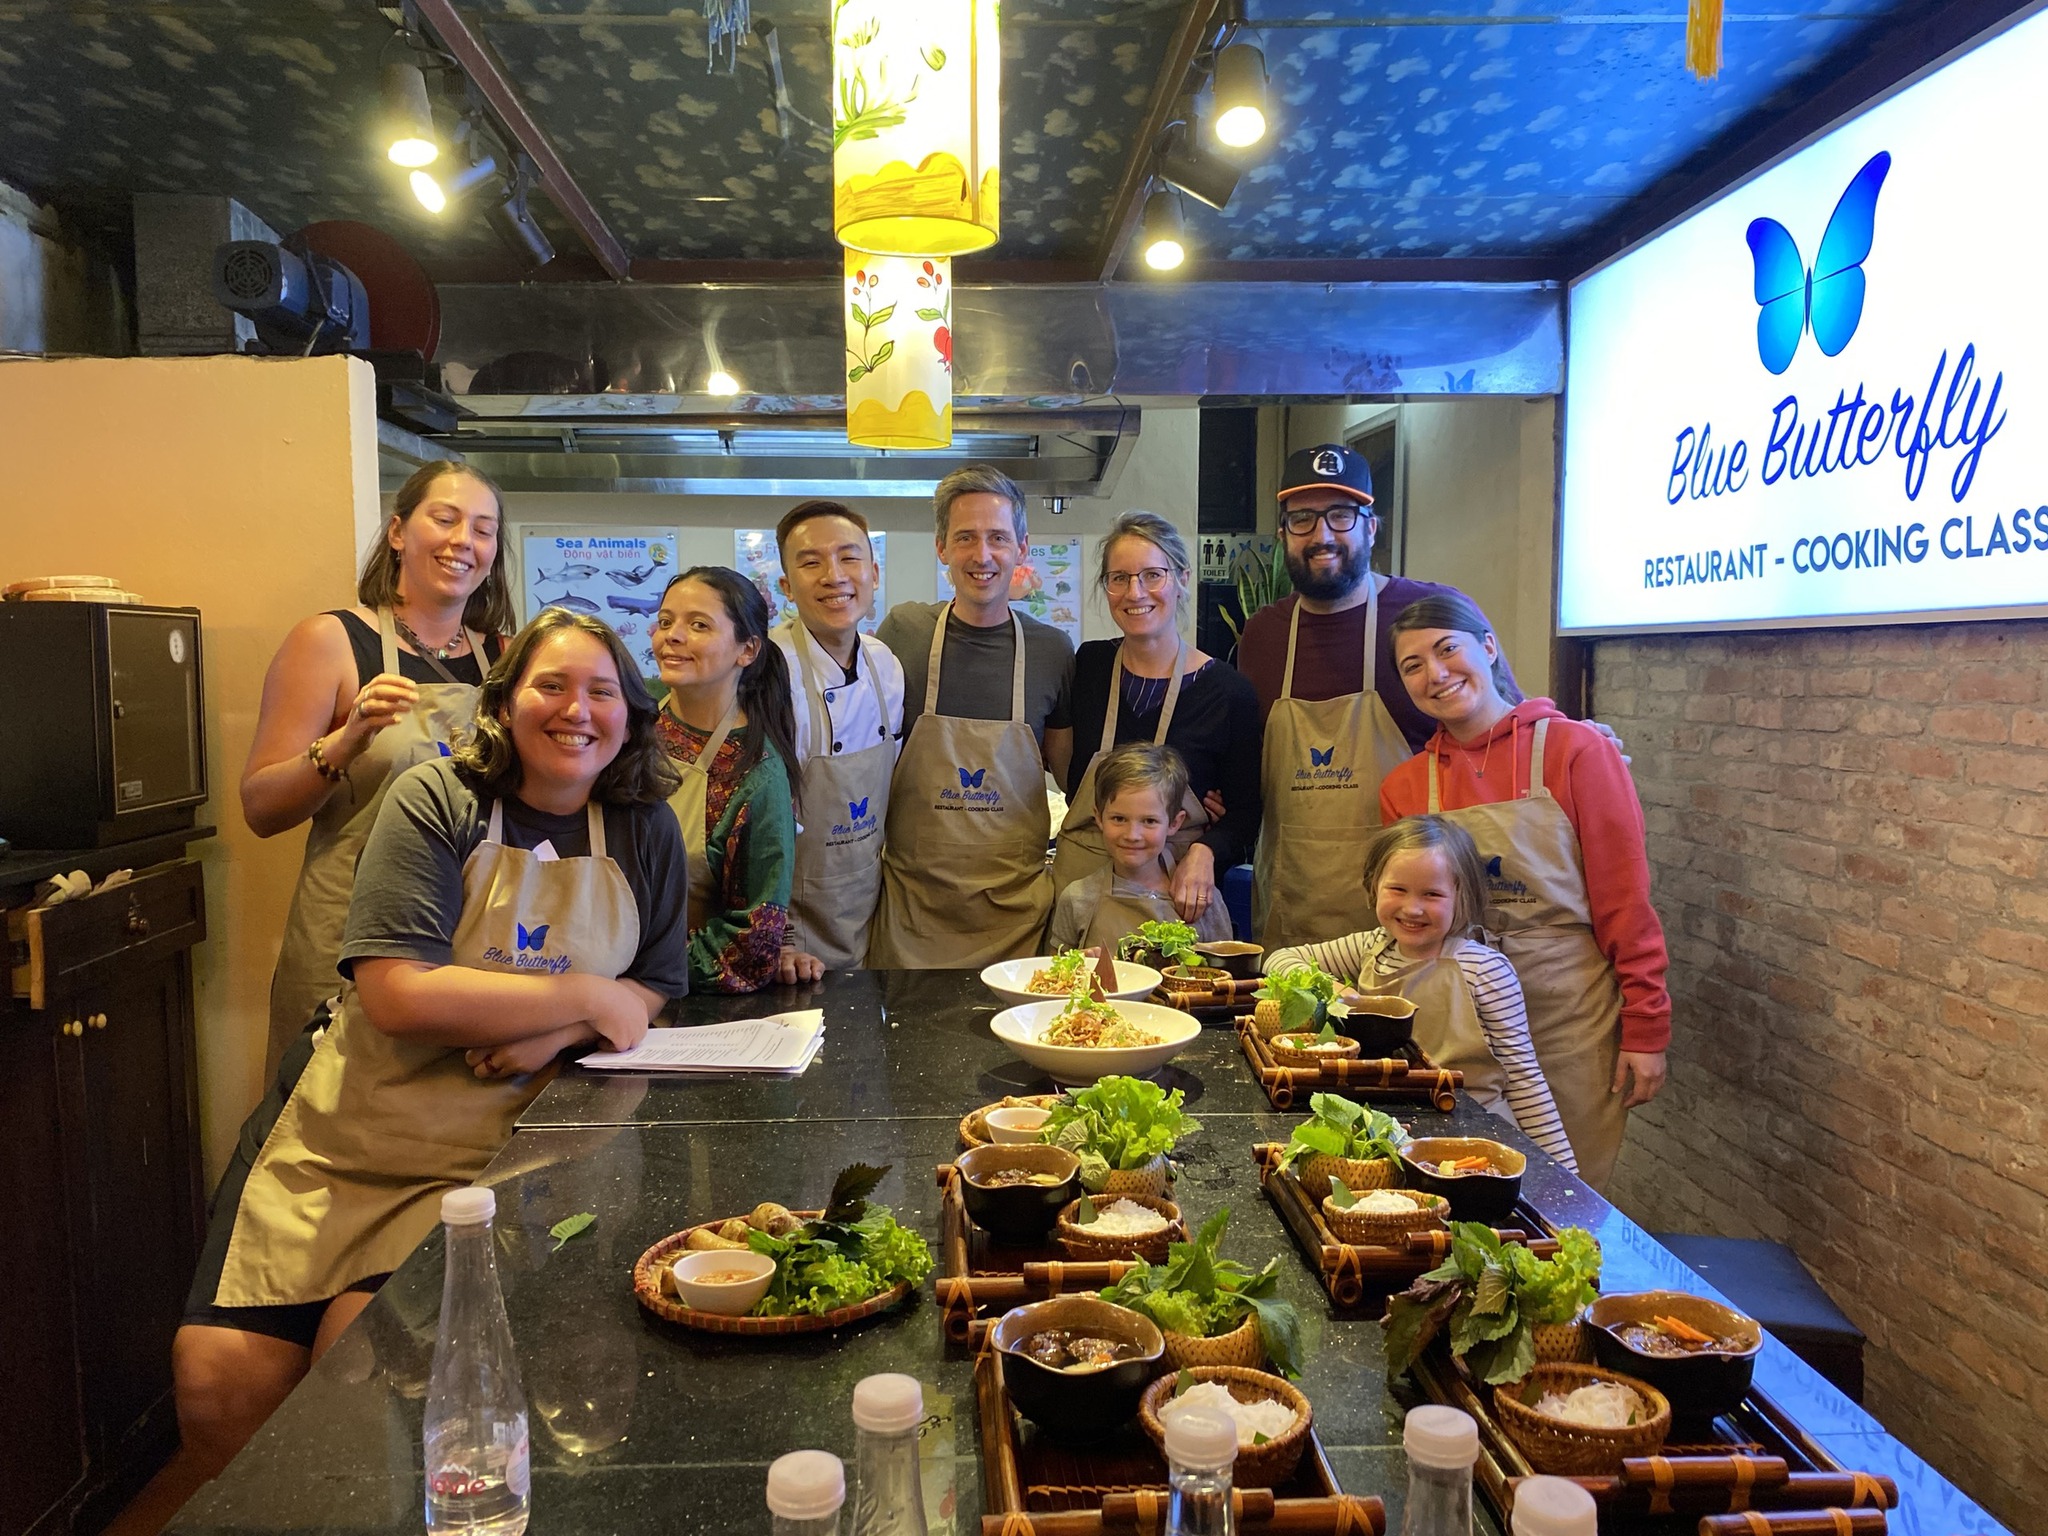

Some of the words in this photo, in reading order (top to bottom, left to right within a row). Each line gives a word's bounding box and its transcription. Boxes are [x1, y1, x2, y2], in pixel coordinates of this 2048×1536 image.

[1667, 422, 1749, 505] Blue
[1762, 342, 2007, 503] Butterfly
[555, 537, 583, 549] Sea
[588, 537, 647, 549] Animals
[1644, 543, 1768, 589] RESTAURANT
[1793, 522, 1929, 574] COOKING
[1940, 505, 2048, 560] CLASS
[563, 549, 592, 560] Động
[1203, 569, 1226, 577] TOILET
[940, 788, 960, 800] Blue
[962, 789, 1000, 805] Butterfly
[482, 946, 513, 966] Blue
[515, 953, 572, 975] Butterfly
